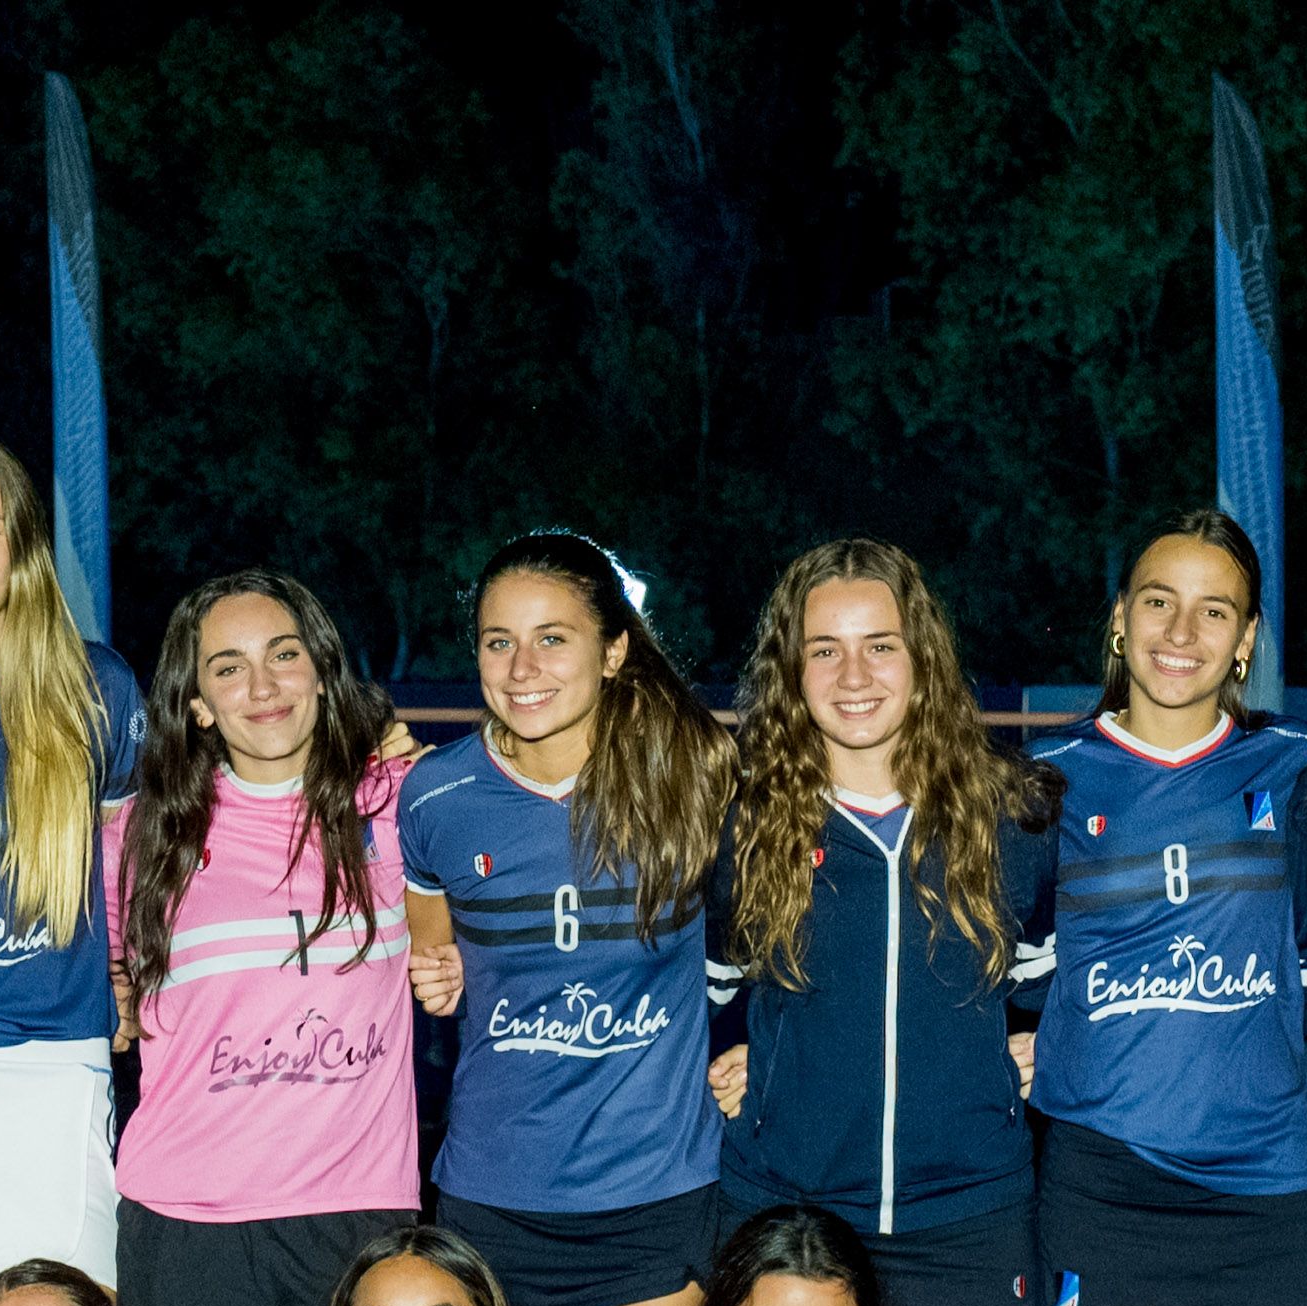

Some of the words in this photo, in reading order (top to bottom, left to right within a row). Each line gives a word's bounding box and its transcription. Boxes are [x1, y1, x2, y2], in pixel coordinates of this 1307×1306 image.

[1163, 843, 1189, 904] 8
[288, 910, 309, 976] 1
[554, 884, 579, 953] 6
[1087, 960, 1194, 1005] Enjoy
[1197, 953, 1276, 999] Cuba
[489, 998, 585, 1043] Enjoy
[587, 994, 670, 1045] Cuba
[211, 1034, 317, 1073] Enjoy
[318, 1023, 387, 1068] Cuba
